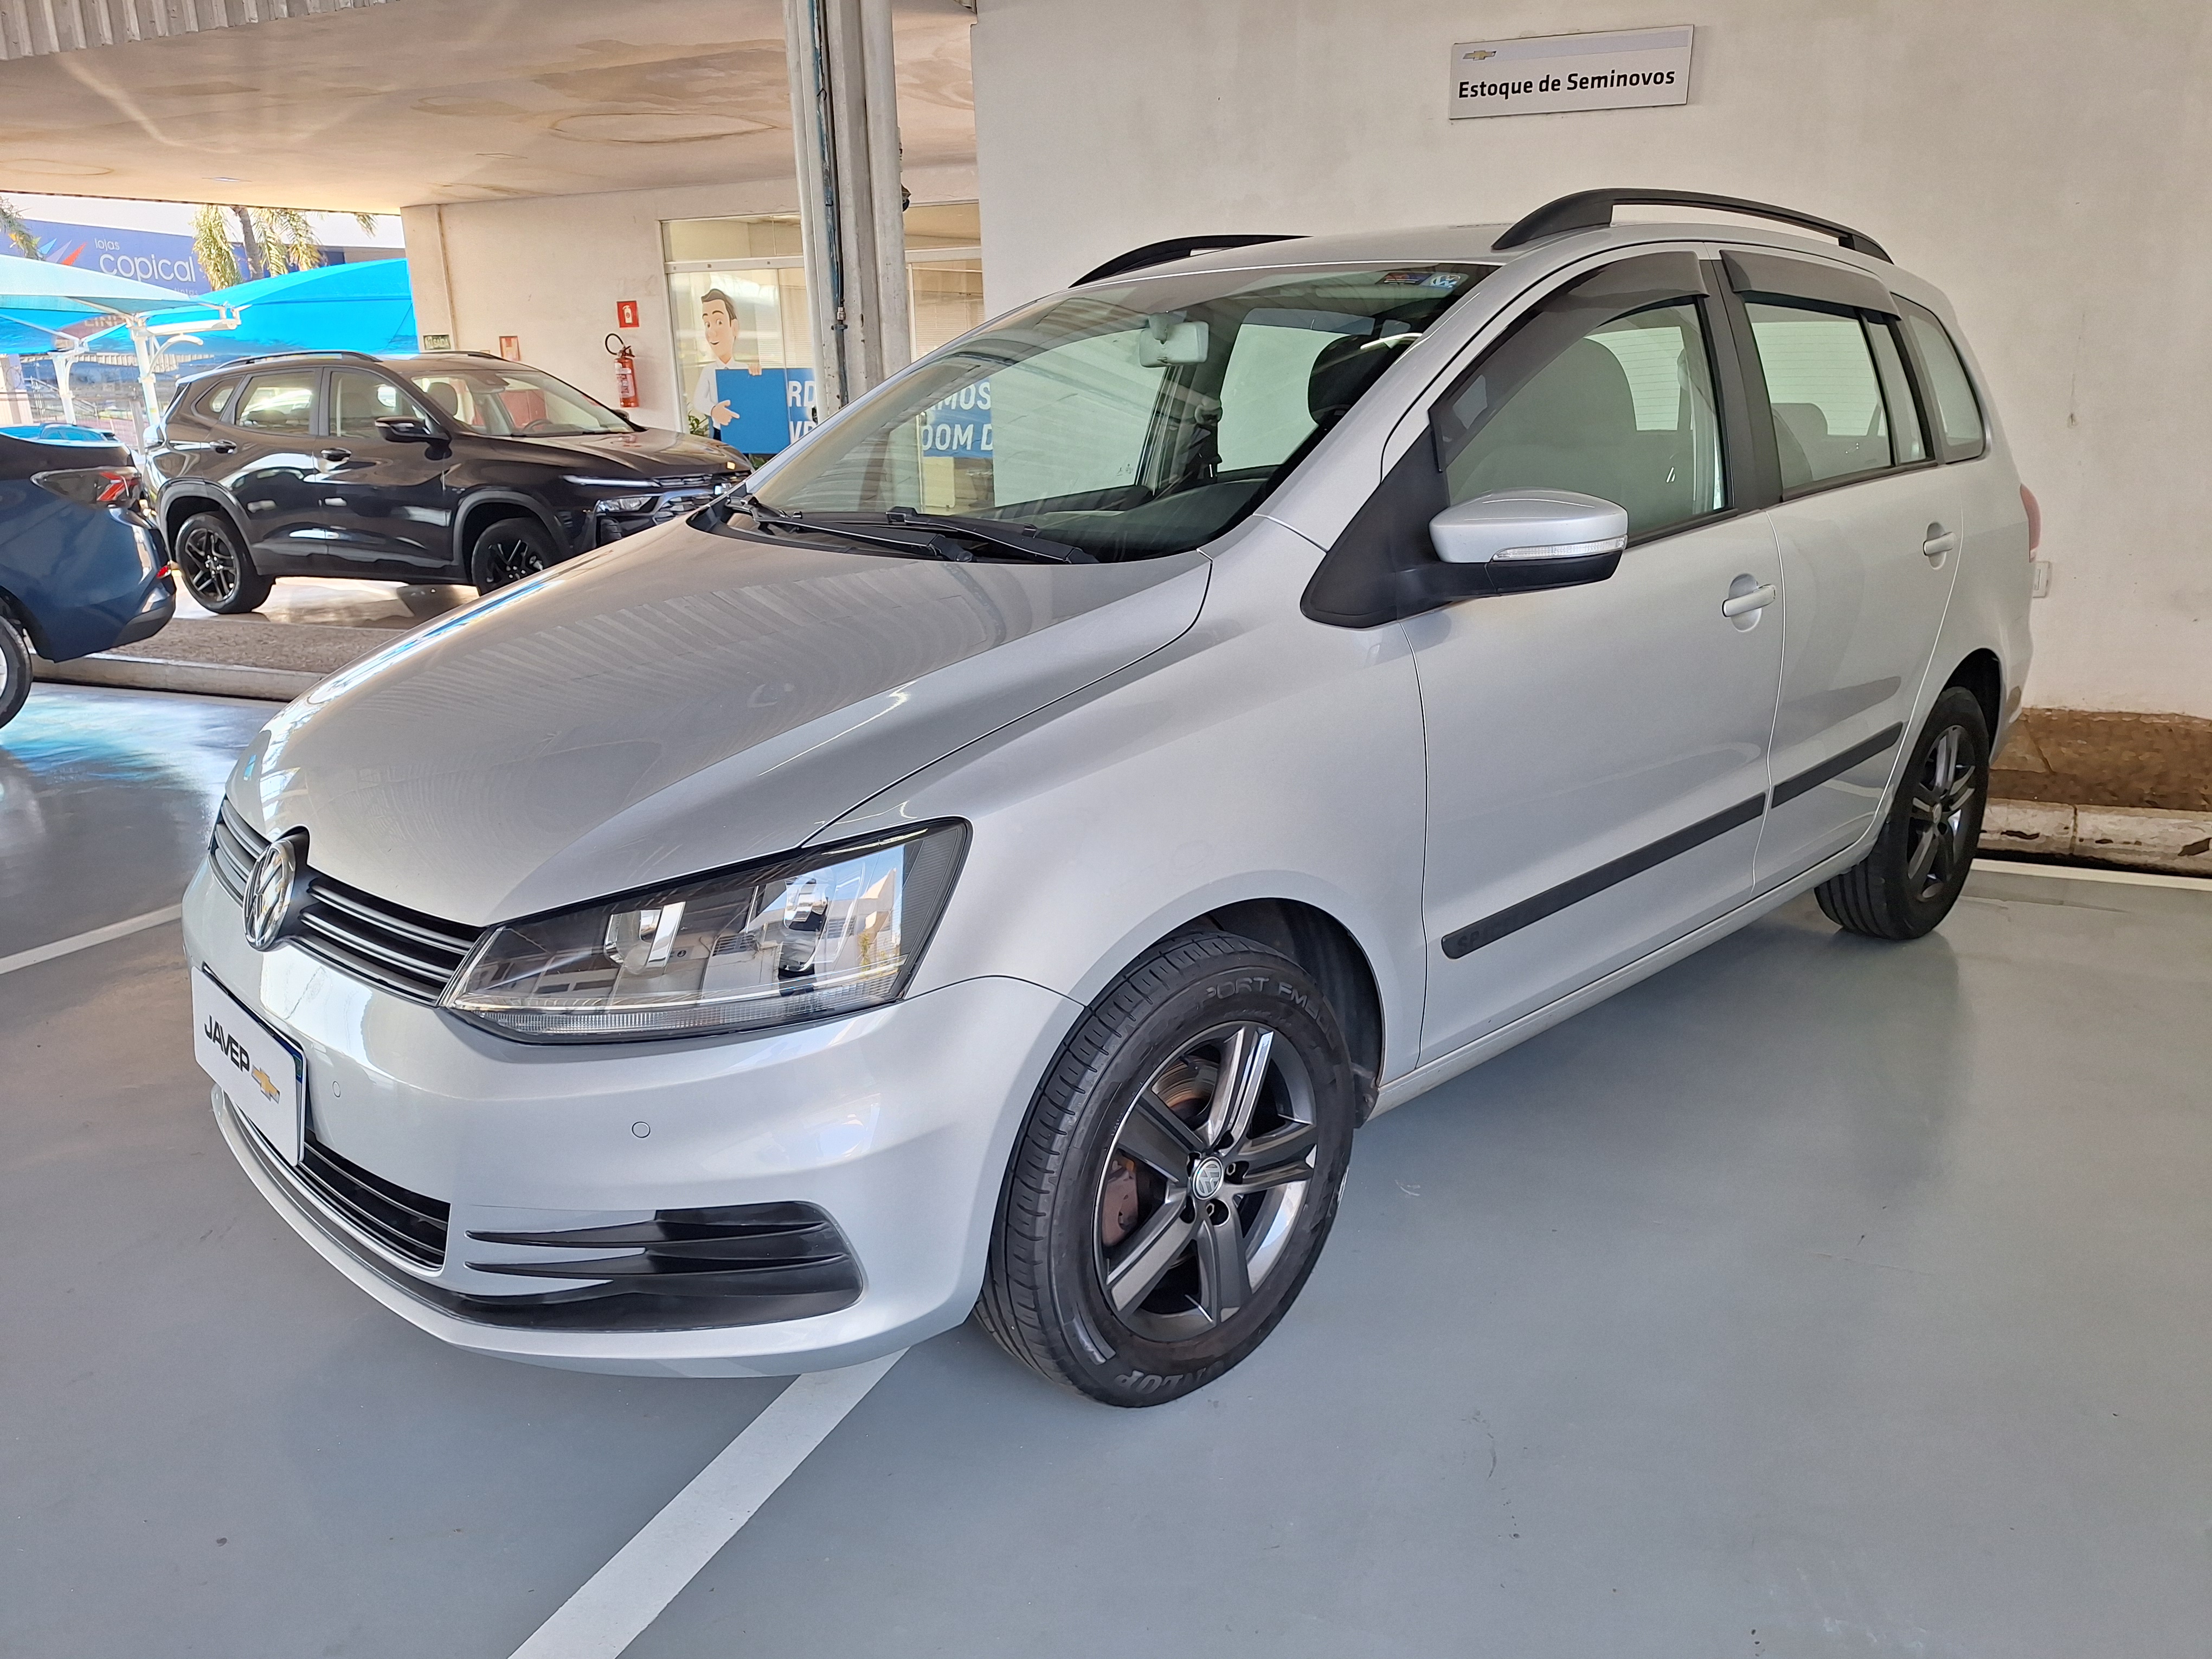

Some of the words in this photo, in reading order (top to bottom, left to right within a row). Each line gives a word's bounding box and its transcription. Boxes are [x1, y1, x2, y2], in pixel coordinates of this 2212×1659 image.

[1458, 80, 1533, 99] Estoque
[1539, 75, 1561, 93] de
[1566, 69, 1675, 91] Seminovos
[94, 238, 120, 251] lojas
[99, 254, 196, 282] copical
[204, 1014, 250, 1073] JAVEP
